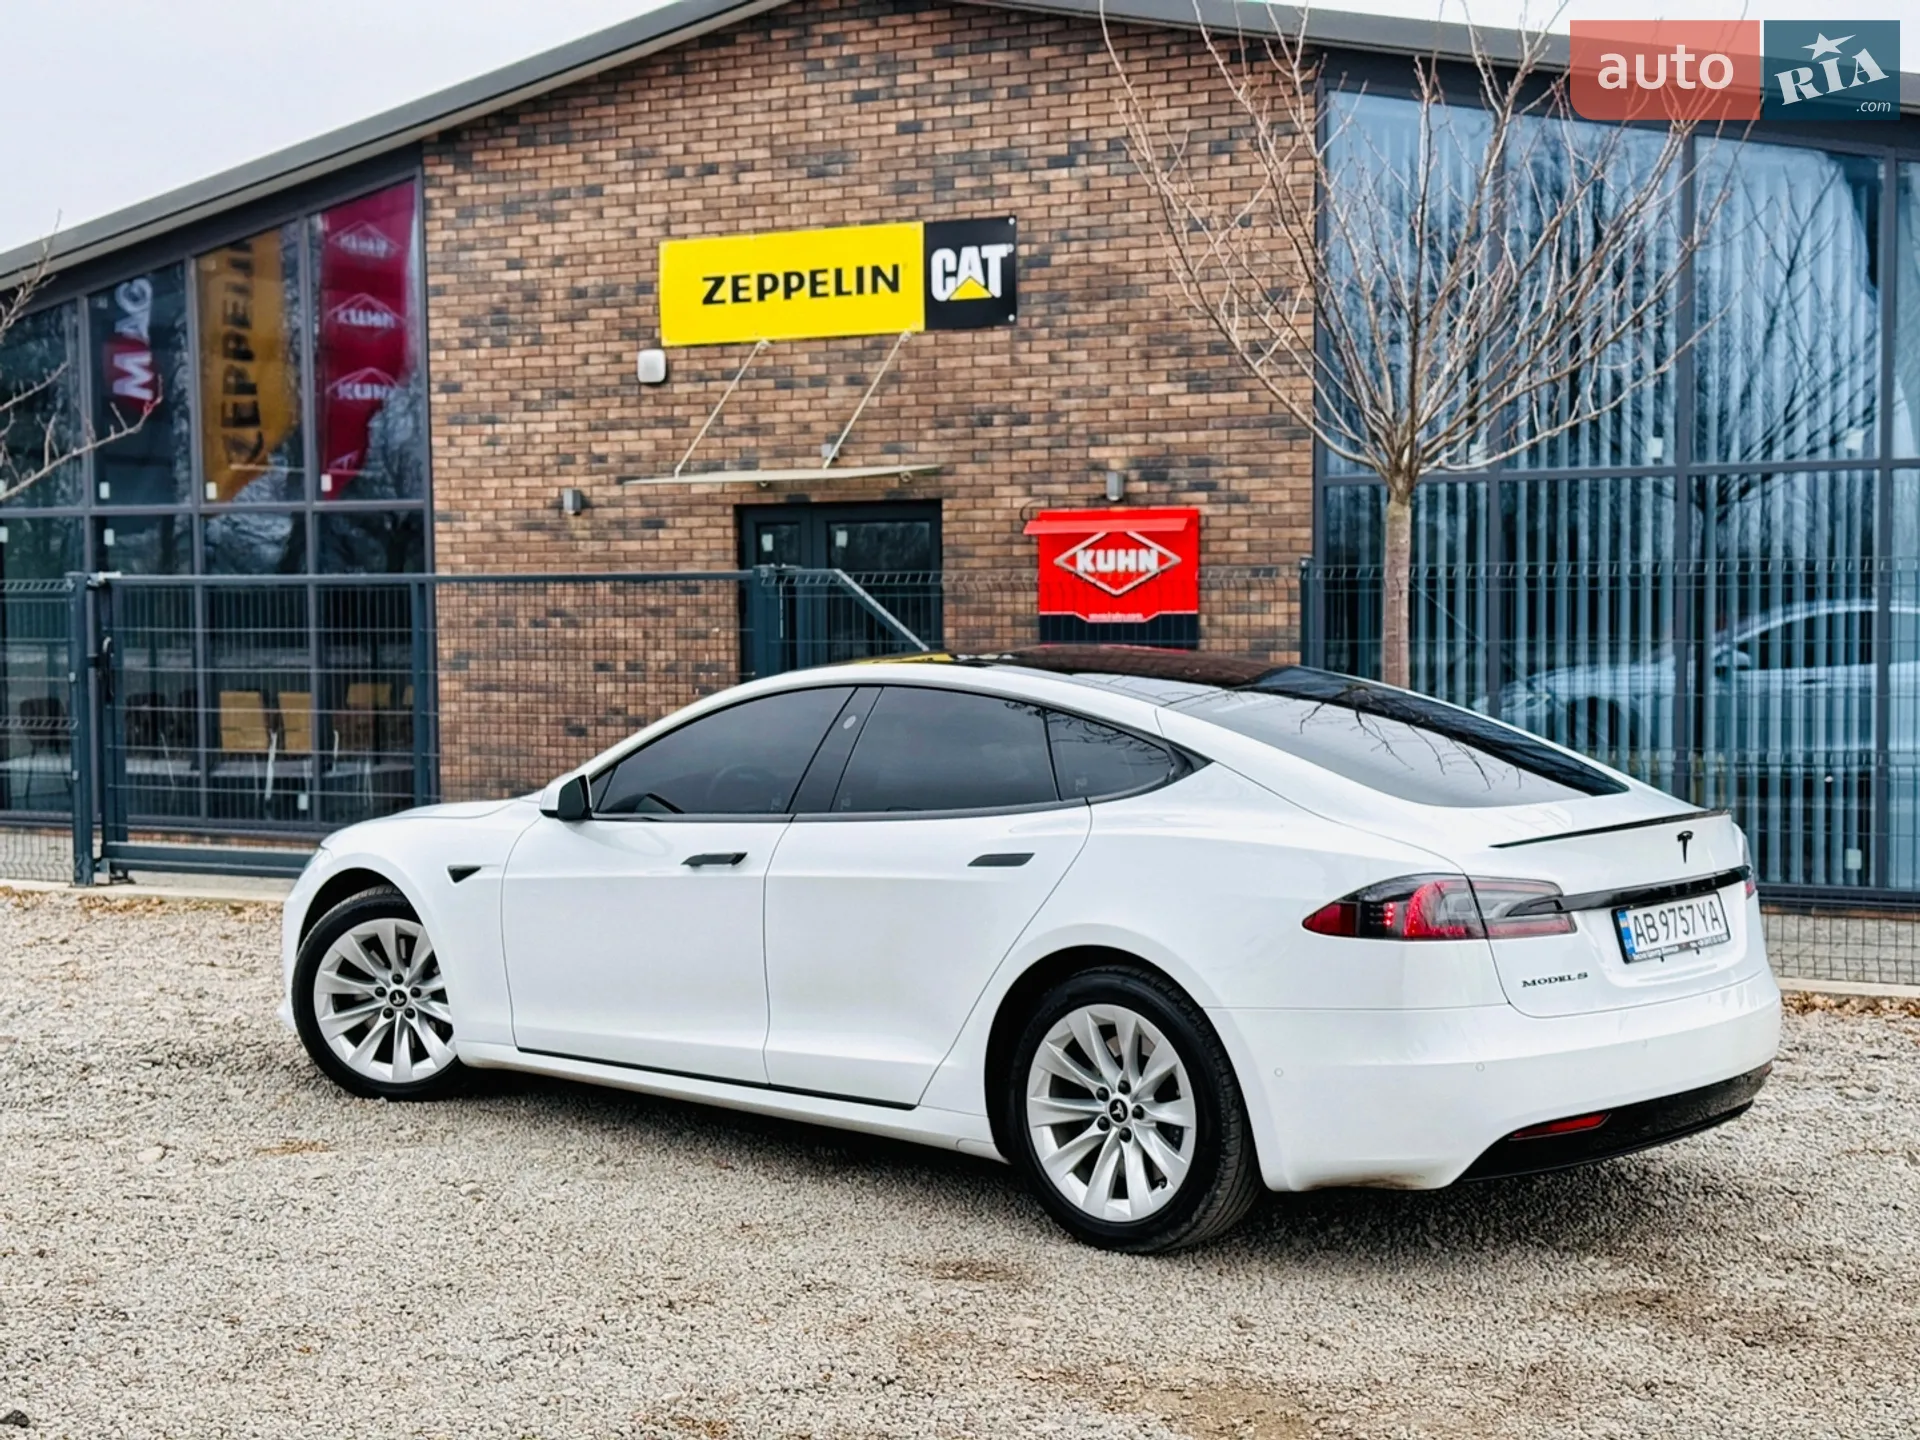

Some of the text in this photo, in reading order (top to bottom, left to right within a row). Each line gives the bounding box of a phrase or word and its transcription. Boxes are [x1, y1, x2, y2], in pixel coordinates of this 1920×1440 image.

[702, 264, 900, 306] ZEPPELIN
[1076, 548, 1159, 573] KUHN
[1521, 972, 1588, 988] MODEL S
